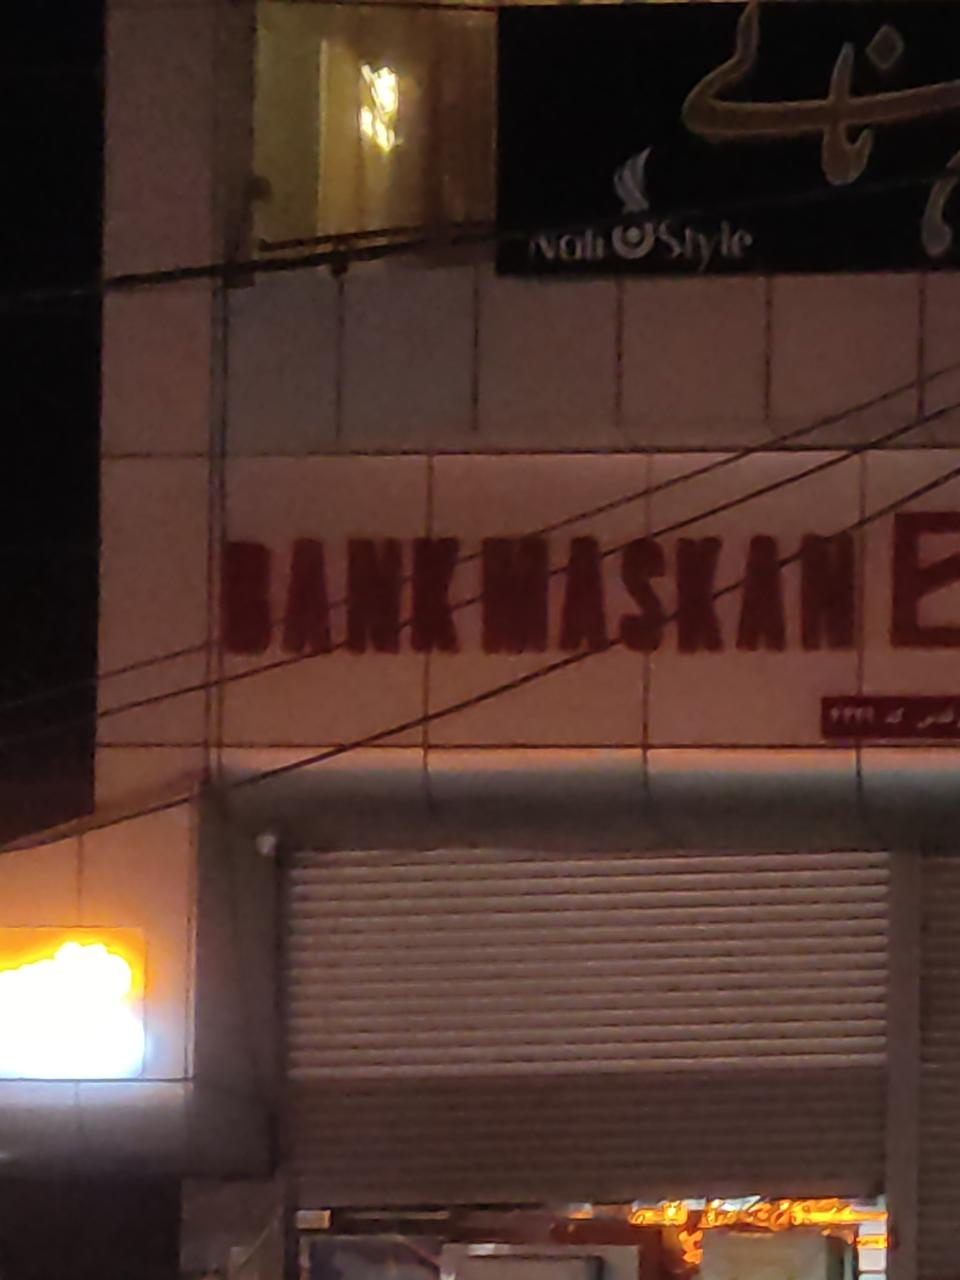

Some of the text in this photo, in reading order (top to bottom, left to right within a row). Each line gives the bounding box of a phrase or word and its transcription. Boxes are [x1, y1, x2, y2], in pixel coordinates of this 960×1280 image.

[655, 219, 755, 273] Style
[220, 532, 857, 656] BANK MASKAN
